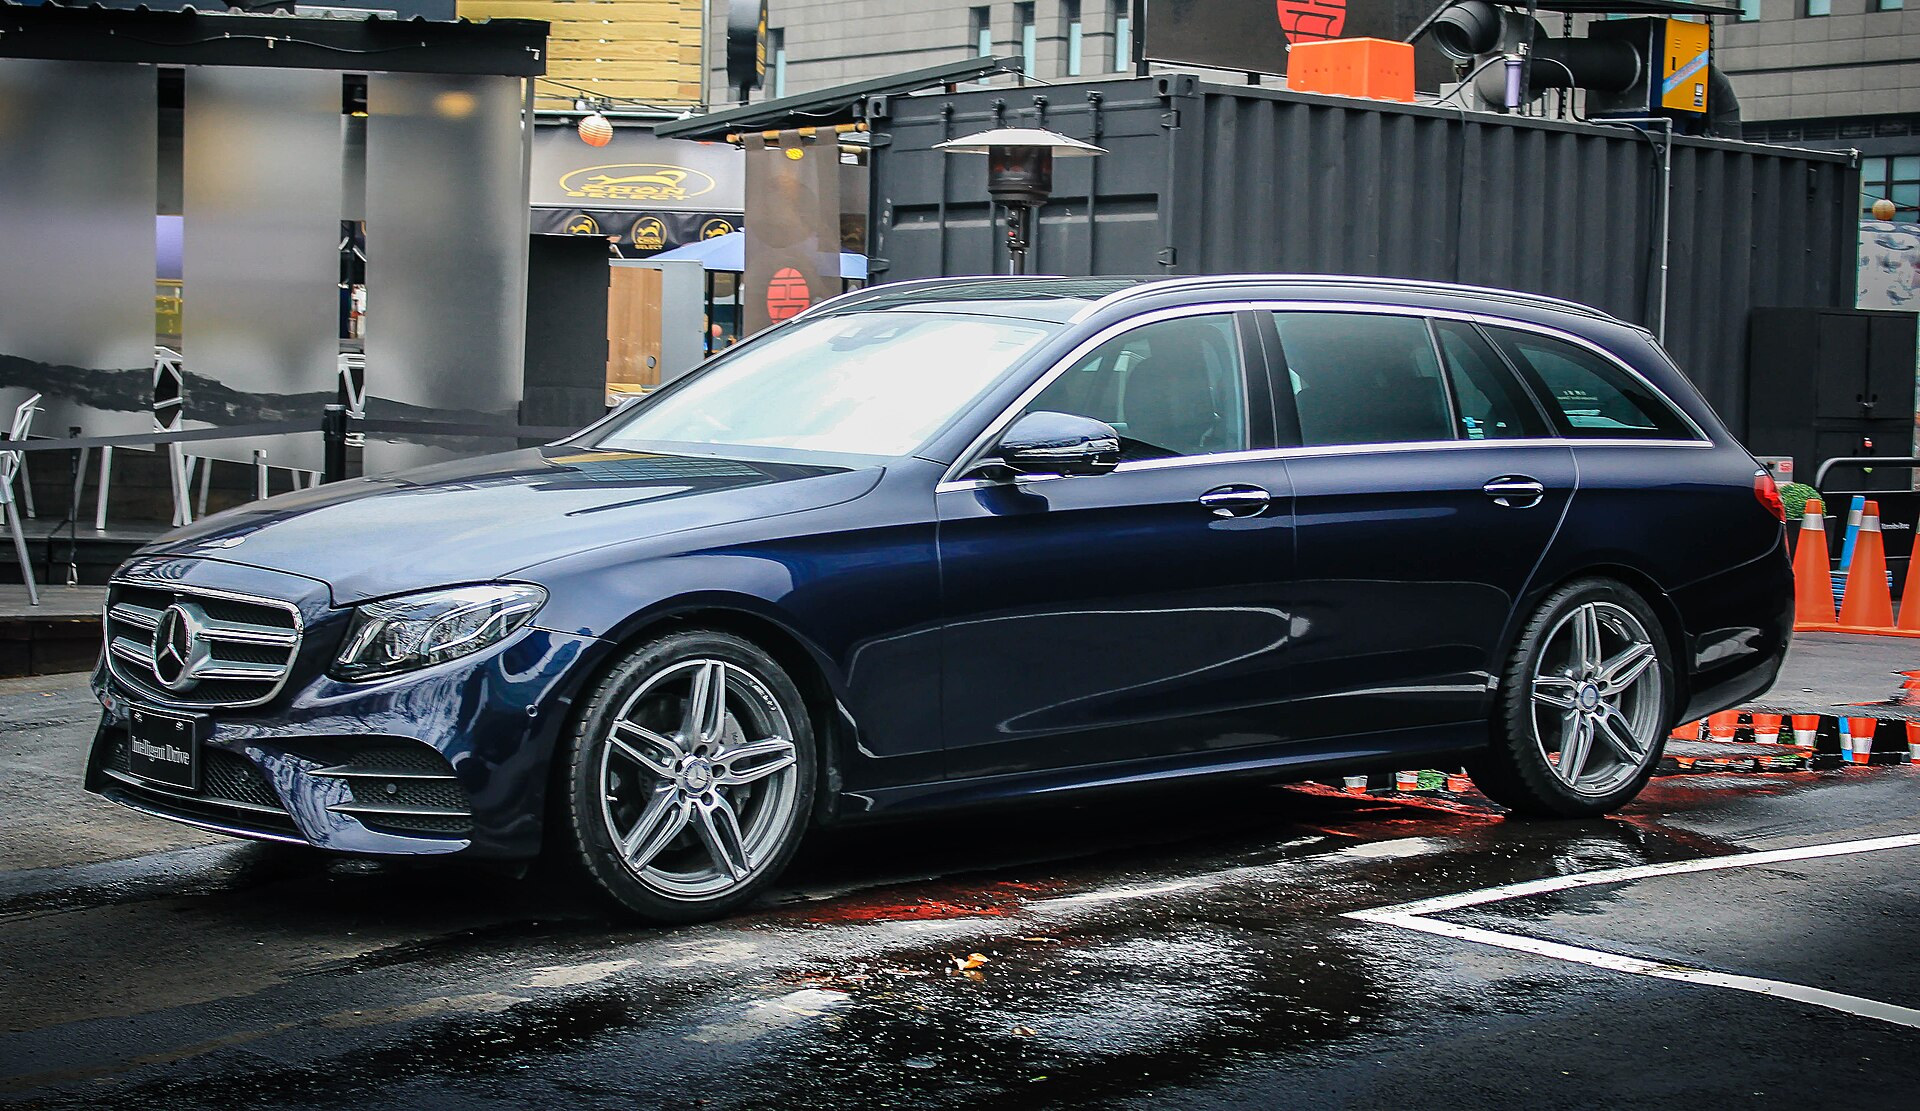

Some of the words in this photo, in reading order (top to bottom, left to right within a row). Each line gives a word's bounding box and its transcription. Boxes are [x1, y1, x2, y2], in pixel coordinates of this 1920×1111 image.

[580, 183, 686, 195] CHON
[566, 191, 690, 200] SELECT
[637, 236, 661, 244] CHON
[131, 735, 166, 762] Intelligent
[166, 743, 190, 765] Drive
